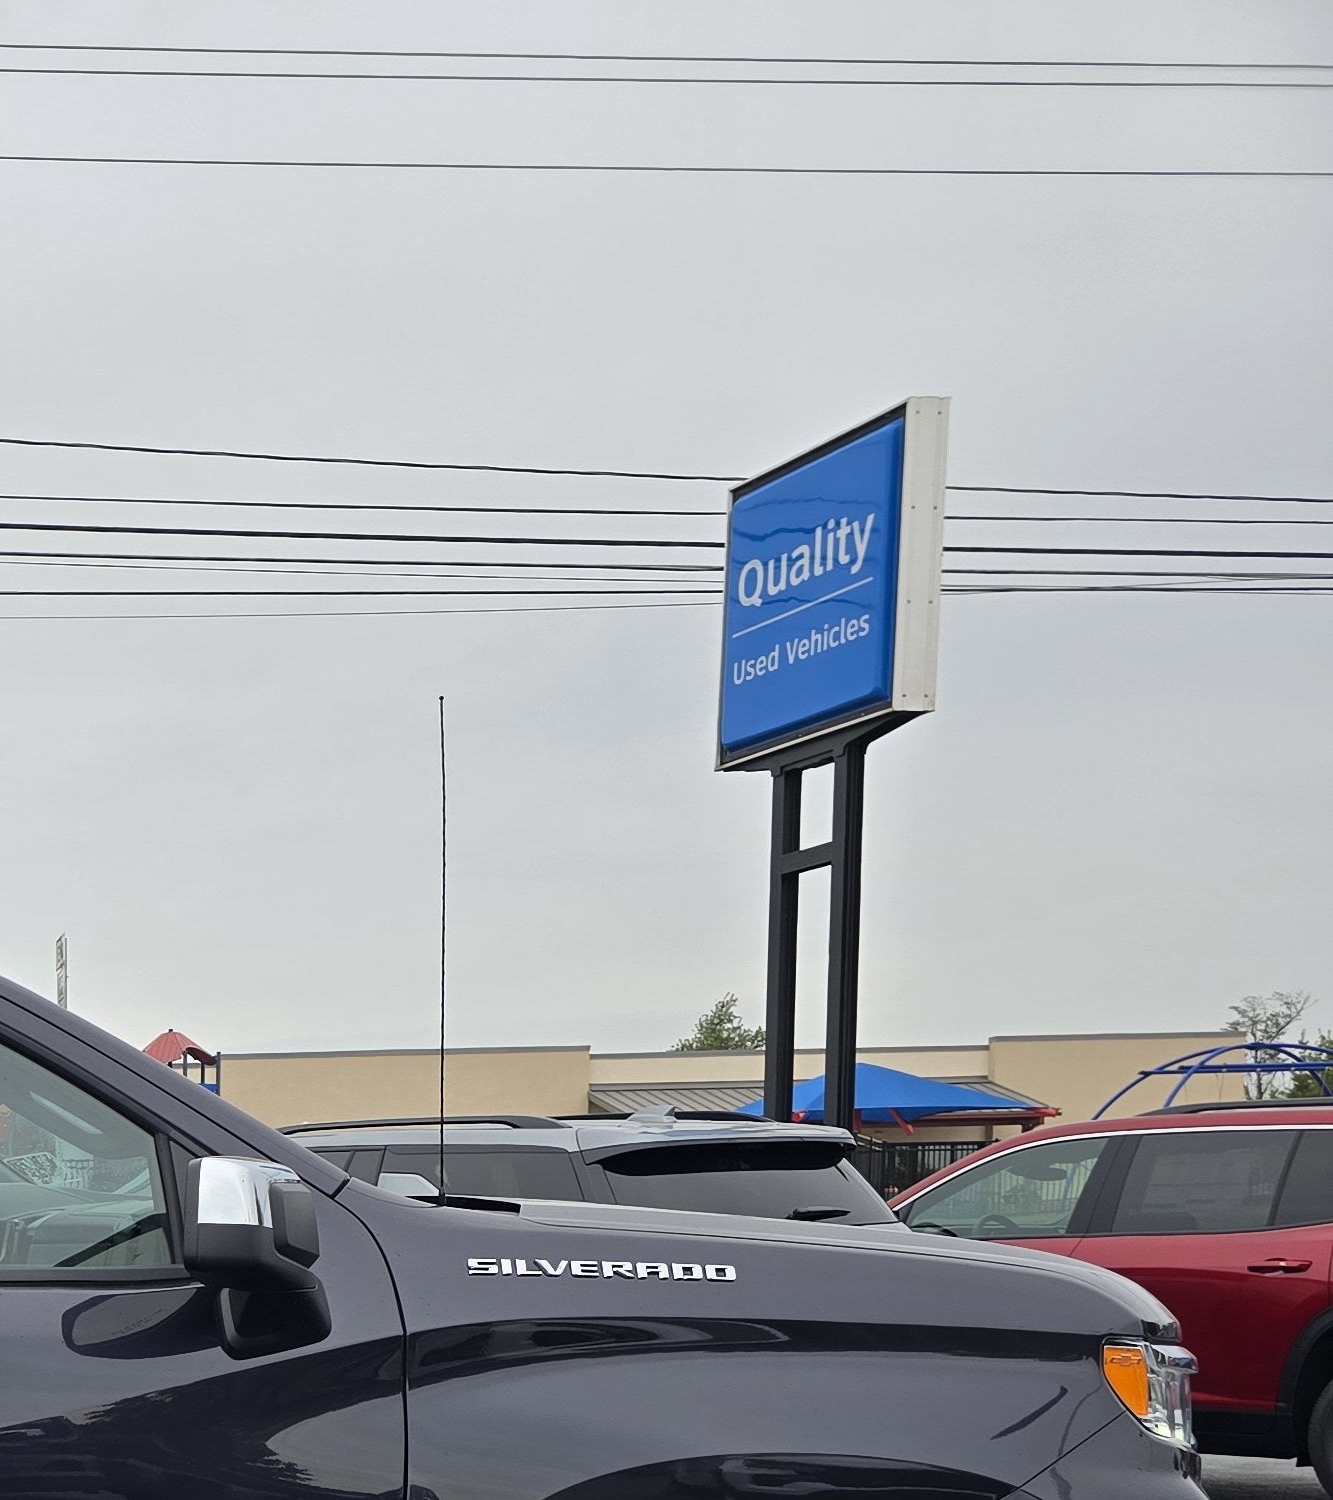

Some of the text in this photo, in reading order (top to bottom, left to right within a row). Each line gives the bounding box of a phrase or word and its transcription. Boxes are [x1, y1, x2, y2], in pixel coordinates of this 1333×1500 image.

[738, 513, 875, 607] Quality
[733, 614, 870, 685] Used Vehicles
[467, 1258, 737, 1281] SILVERADO
